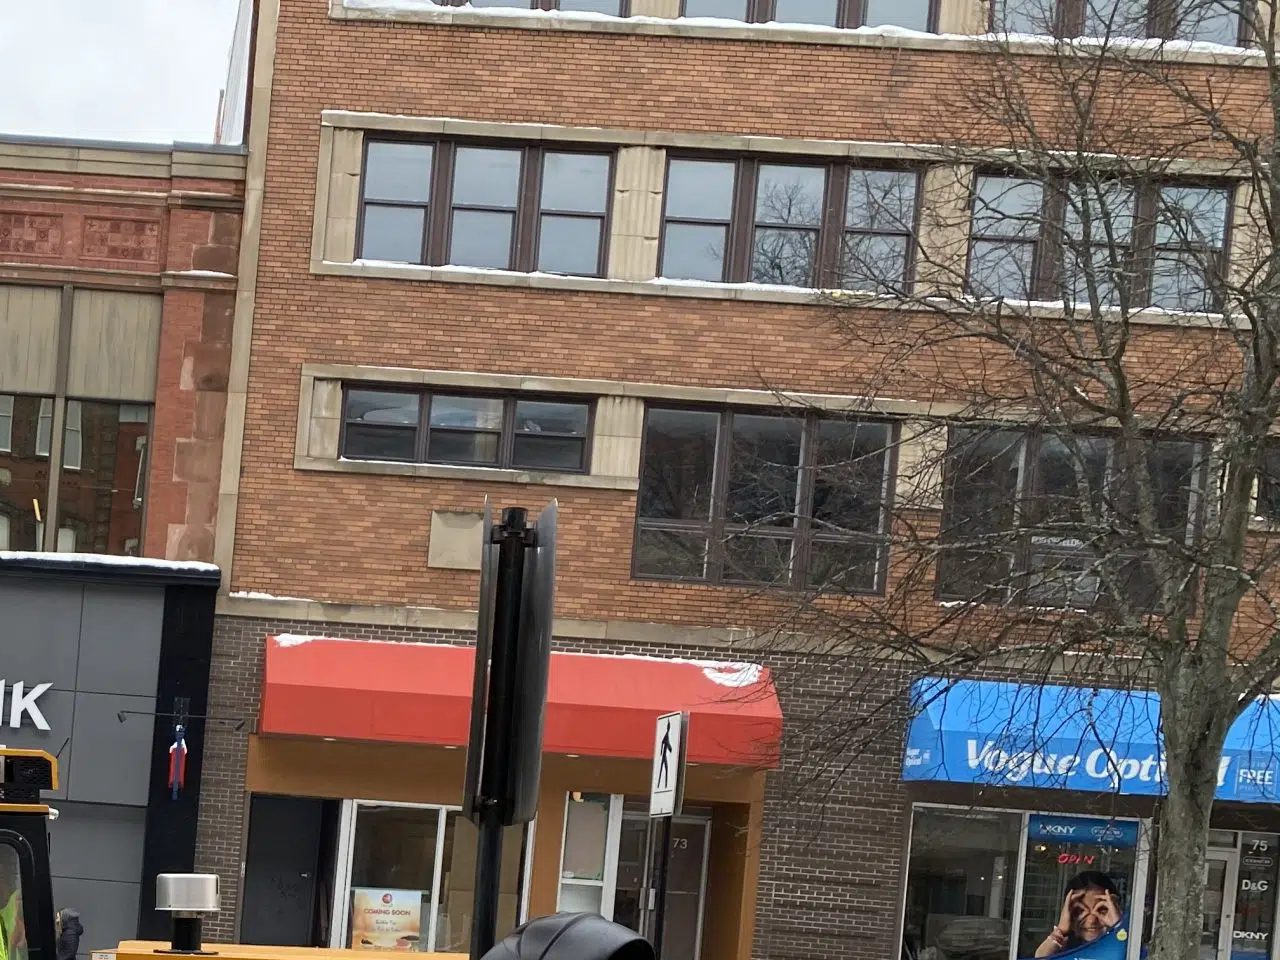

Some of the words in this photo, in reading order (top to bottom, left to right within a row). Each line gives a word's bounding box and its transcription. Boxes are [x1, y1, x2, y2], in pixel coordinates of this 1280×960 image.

[967, 738, 1080, 781] Vogue
[1085, 747, 1231, 790] Optil
[1239, 768, 1274, 785] FREE
[673, 837, 688, 849] 73
[1252, 839, 1268, 851] 75
[1241, 879, 1269, 891] D&G
[363, 908, 391, 916] COMING
[1232, 930, 1269, 940] DKNY
